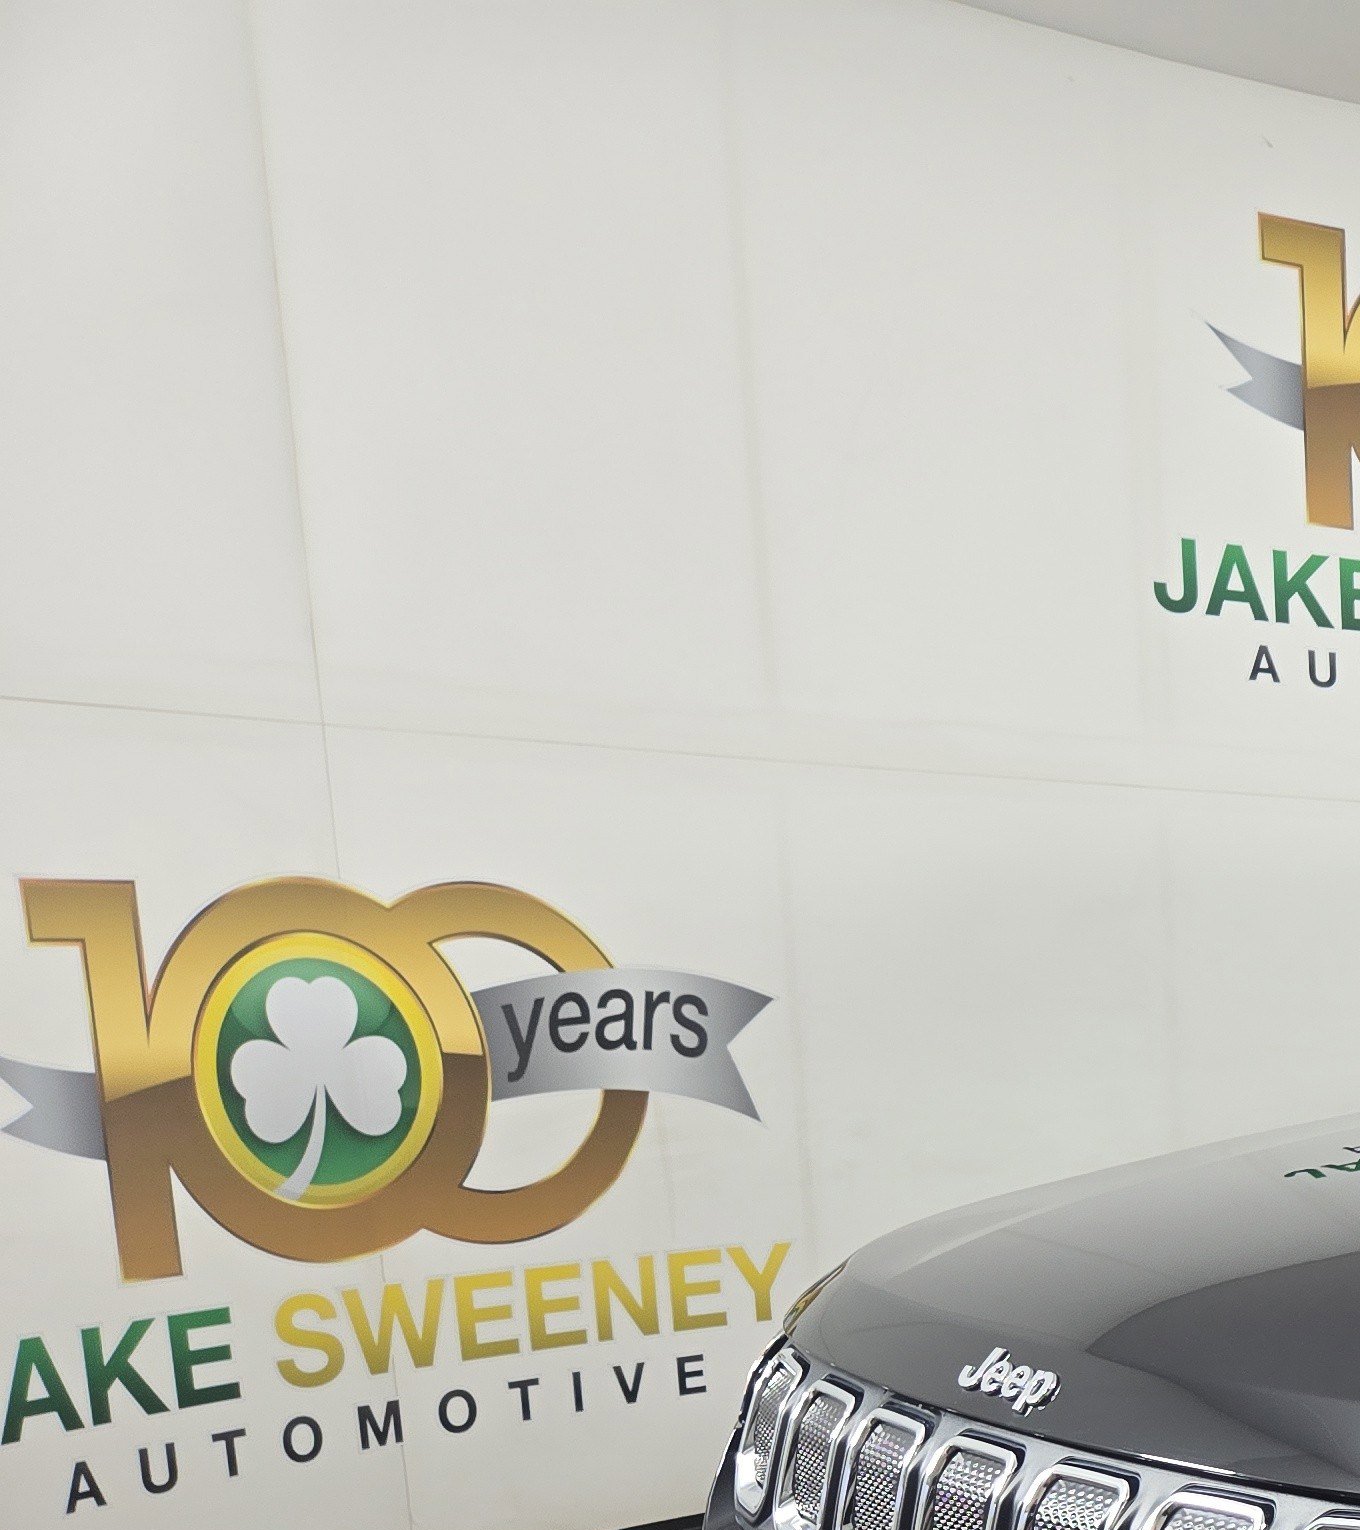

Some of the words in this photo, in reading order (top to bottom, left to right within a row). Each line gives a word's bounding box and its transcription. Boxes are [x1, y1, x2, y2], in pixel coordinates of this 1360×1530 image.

[17, 875, 650, 1283] 100
[500, 986, 710, 1084] years
[273, 1242, 793, 1390] SWEENEY
[957, 1346, 1063, 1417] Jeep
[66, 1353, 708, 1515] AUTOMOTIVE
